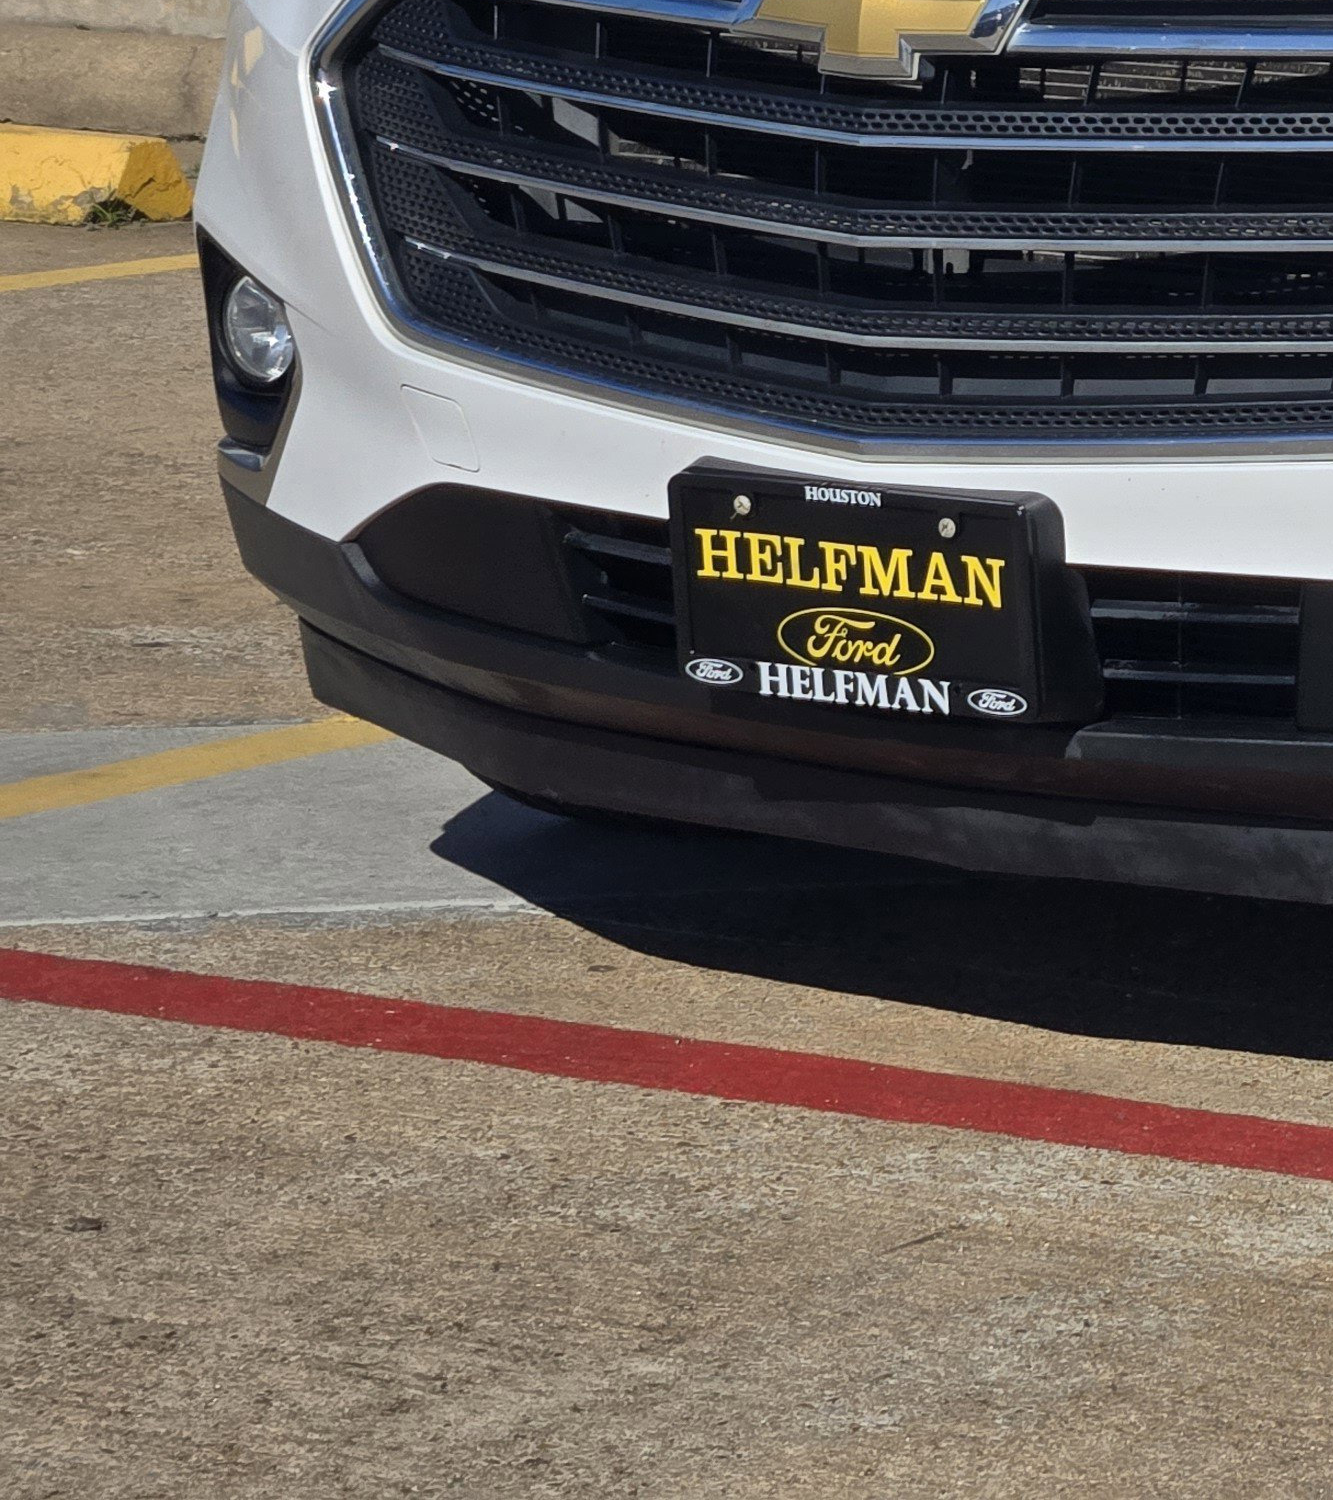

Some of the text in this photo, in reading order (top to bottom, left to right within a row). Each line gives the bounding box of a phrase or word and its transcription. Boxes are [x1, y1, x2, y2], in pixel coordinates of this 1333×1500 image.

[804, 485, 883, 508] HOUSTON
[694, 528, 1006, 608] HELFMAN
[806, 613, 902, 667] Ford
[695, 661, 733, 680] Ford
[757, 661, 951, 715] HELFMAN
[978, 692, 1016, 711] Ford
